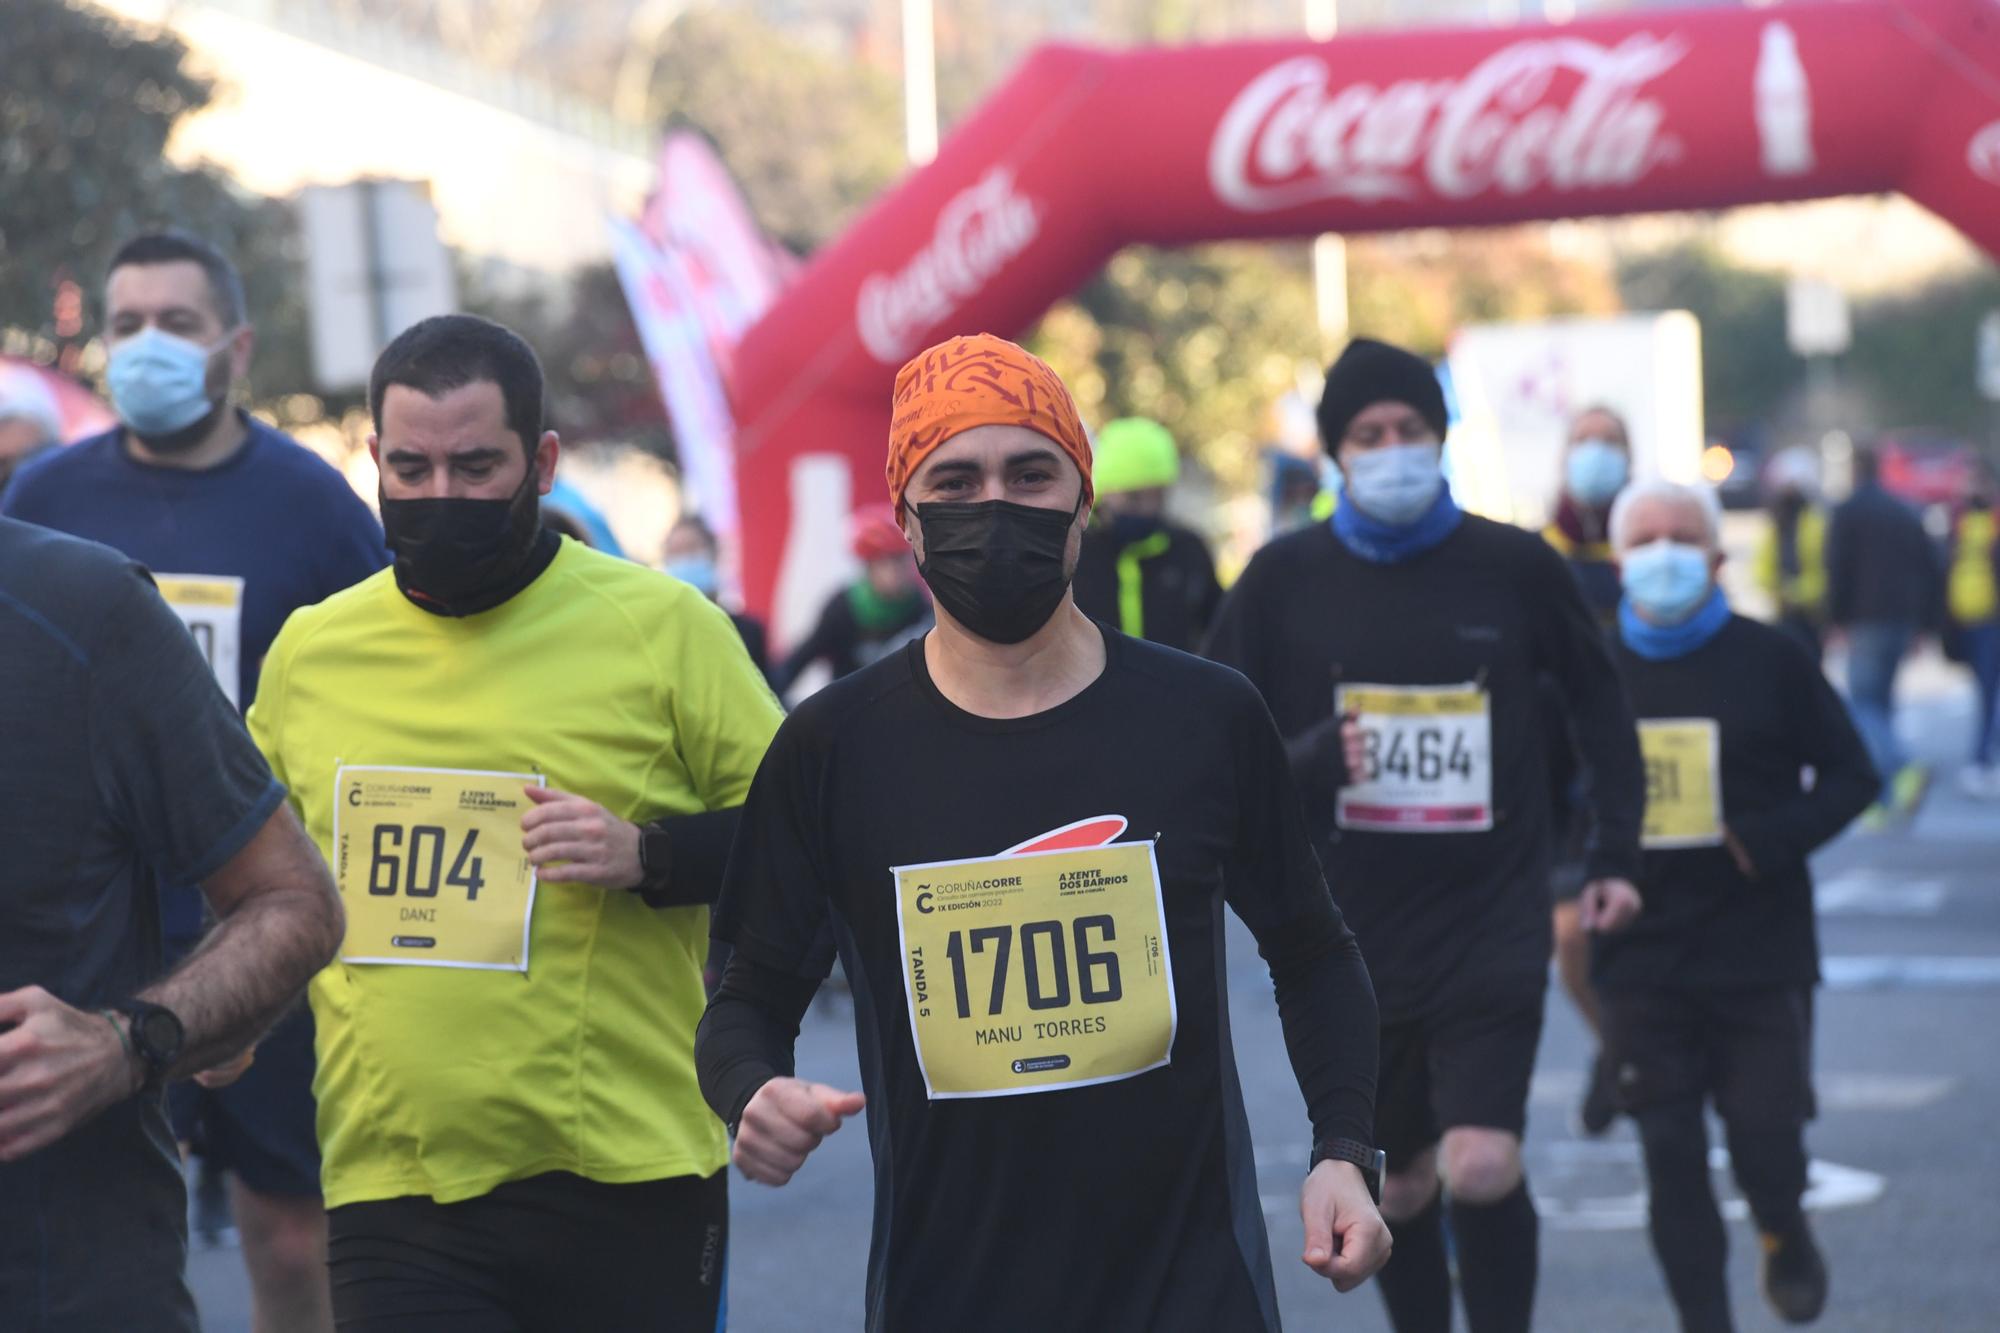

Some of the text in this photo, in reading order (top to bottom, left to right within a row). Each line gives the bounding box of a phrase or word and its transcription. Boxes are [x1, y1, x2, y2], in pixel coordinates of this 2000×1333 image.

[339, 833, 349, 879] TANDA
[369, 824, 485, 901] 604
[936, 876, 1022, 894] CORUÑACORRE
[1059, 869, 1101, 881] A XENTE
[1060, 875, 1128, 890] DOS BARRIOS
[400, 908, 437, 922] DANI
[948, 901, 981, 911] EDICIÓN
[982, 898, 1002, 908] 2022
[1150, 936, 1159, 958] 1706
[946, 914, 1122, 1019] 1706
[911, 946, 930, 1017] TANDA 5
[975, 1016, 1107, 1045] MANU TORRES
